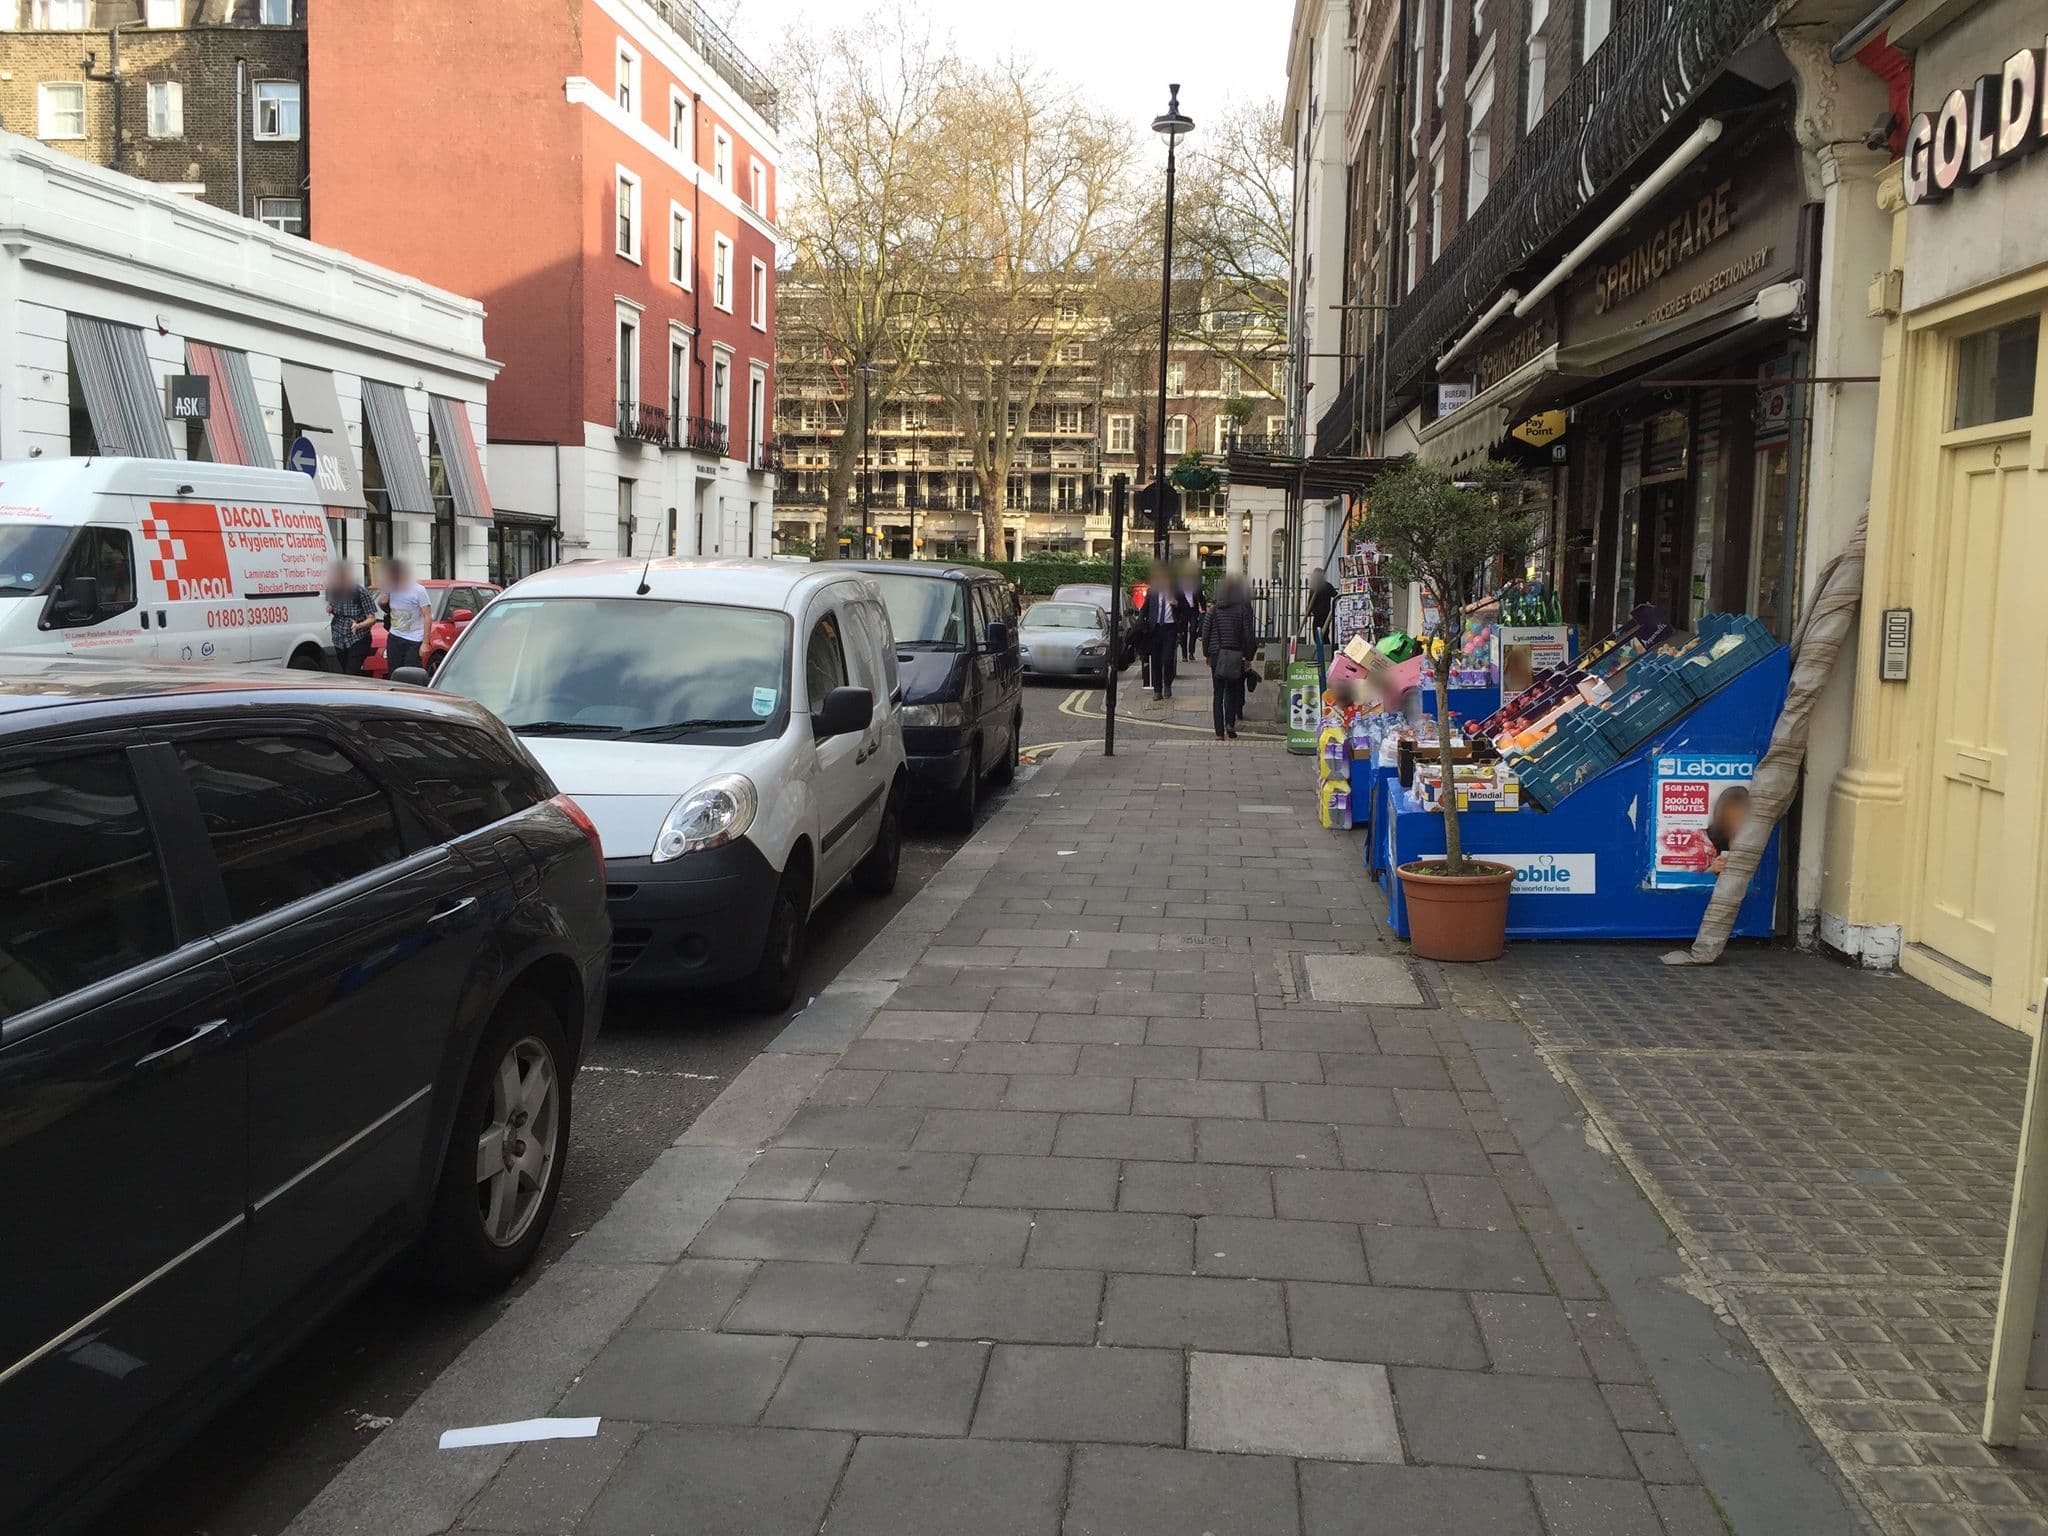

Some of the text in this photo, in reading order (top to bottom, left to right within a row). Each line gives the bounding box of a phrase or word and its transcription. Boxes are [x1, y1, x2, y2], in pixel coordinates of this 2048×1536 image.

[1594, 178, 1732, 315] SPRINGFARE
[1690, 245, 1769, 305] CONFECTIONARY
[175, 397, 199, 416] ASK
[1526, 420, 1544, 429] Pay
[1526, 428, 1553, 436] Point
[1993, 445, 2002, 468] 6
[316, 454, 346, 492] ASK
[220, 506, 324, 535] DACOL Flooring
[228, 532, 327, 552] & Hygienic Cladding
[178, 577, 233, 600] DACOL
[207, 606, 289, 628] 01803 393093
[1513, 633, 1555, 643] Lycamobile
[1676, 758, 1752, 776] Lebara
[1664, 784, 1706, 792] 5GB DATA
[1664, 797, 1704, 805] 2000 UK
[1664, 804, 1706, 812] MINUTES
[1666, 833, 1692, 845] £17
[1515, 864, 1571, 883] obile
